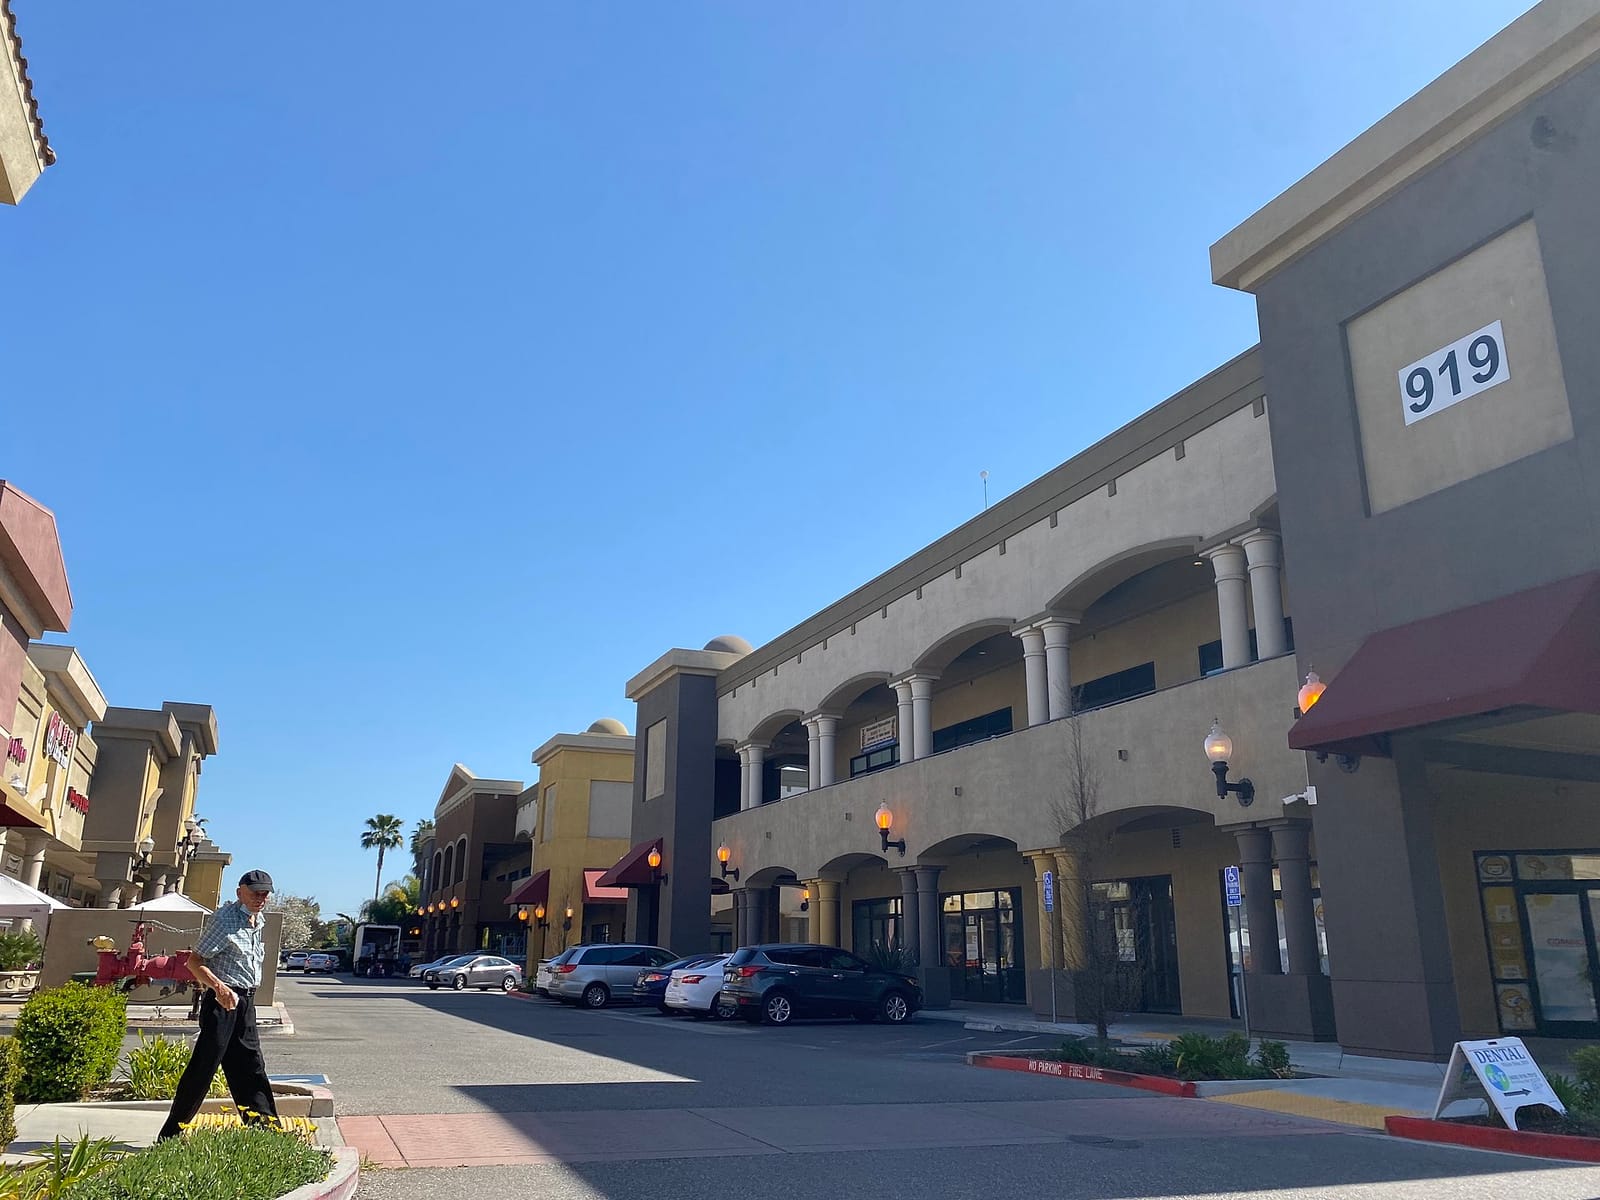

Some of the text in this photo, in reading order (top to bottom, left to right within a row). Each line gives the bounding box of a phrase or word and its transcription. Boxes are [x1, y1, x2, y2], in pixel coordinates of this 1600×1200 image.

[1405, 335, 1500, 413] 919
[1473, 1046, 1526, 1064] DENTAL
[1029, 1060, 1103, 1080] NO PARKING FIRE LANE
